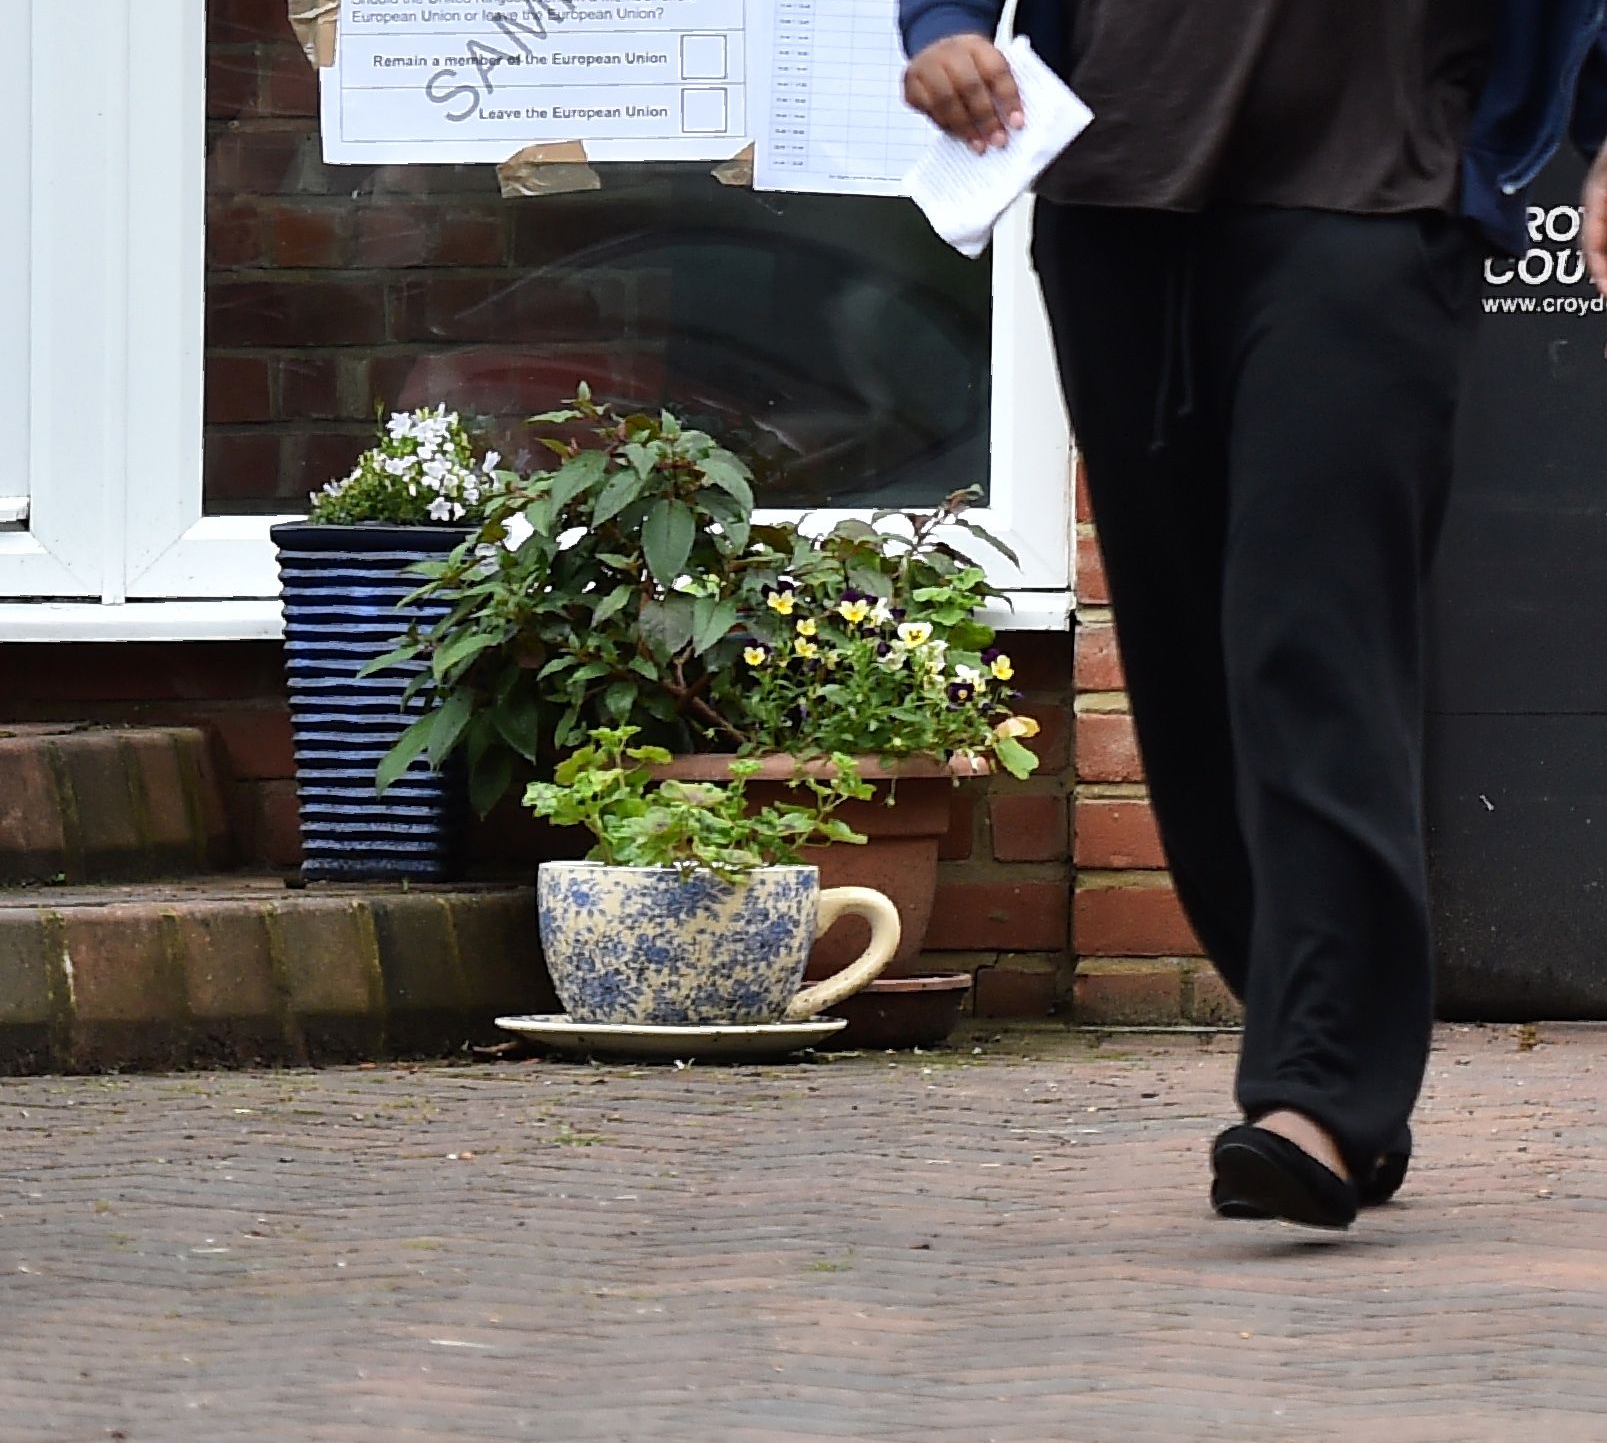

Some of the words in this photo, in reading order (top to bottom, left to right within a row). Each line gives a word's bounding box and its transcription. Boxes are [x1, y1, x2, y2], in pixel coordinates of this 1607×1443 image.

[352, 11, 416, 24] European
[421, 11, 460, 22] Union
[617, 8, 663, 19] Union?
[373, 55, 427, 67] Remain
[444, 54, 501, 66] member
[525, 53, 546, 65] the
[552, 52, 621, 68] European
[625, 52, 667, 65] Union
[479, 108, 521, 120] Leave
[526, 107, 547, 119] the
[552, 107, 621, 122] European
[626, 106, 667, 118] Union
